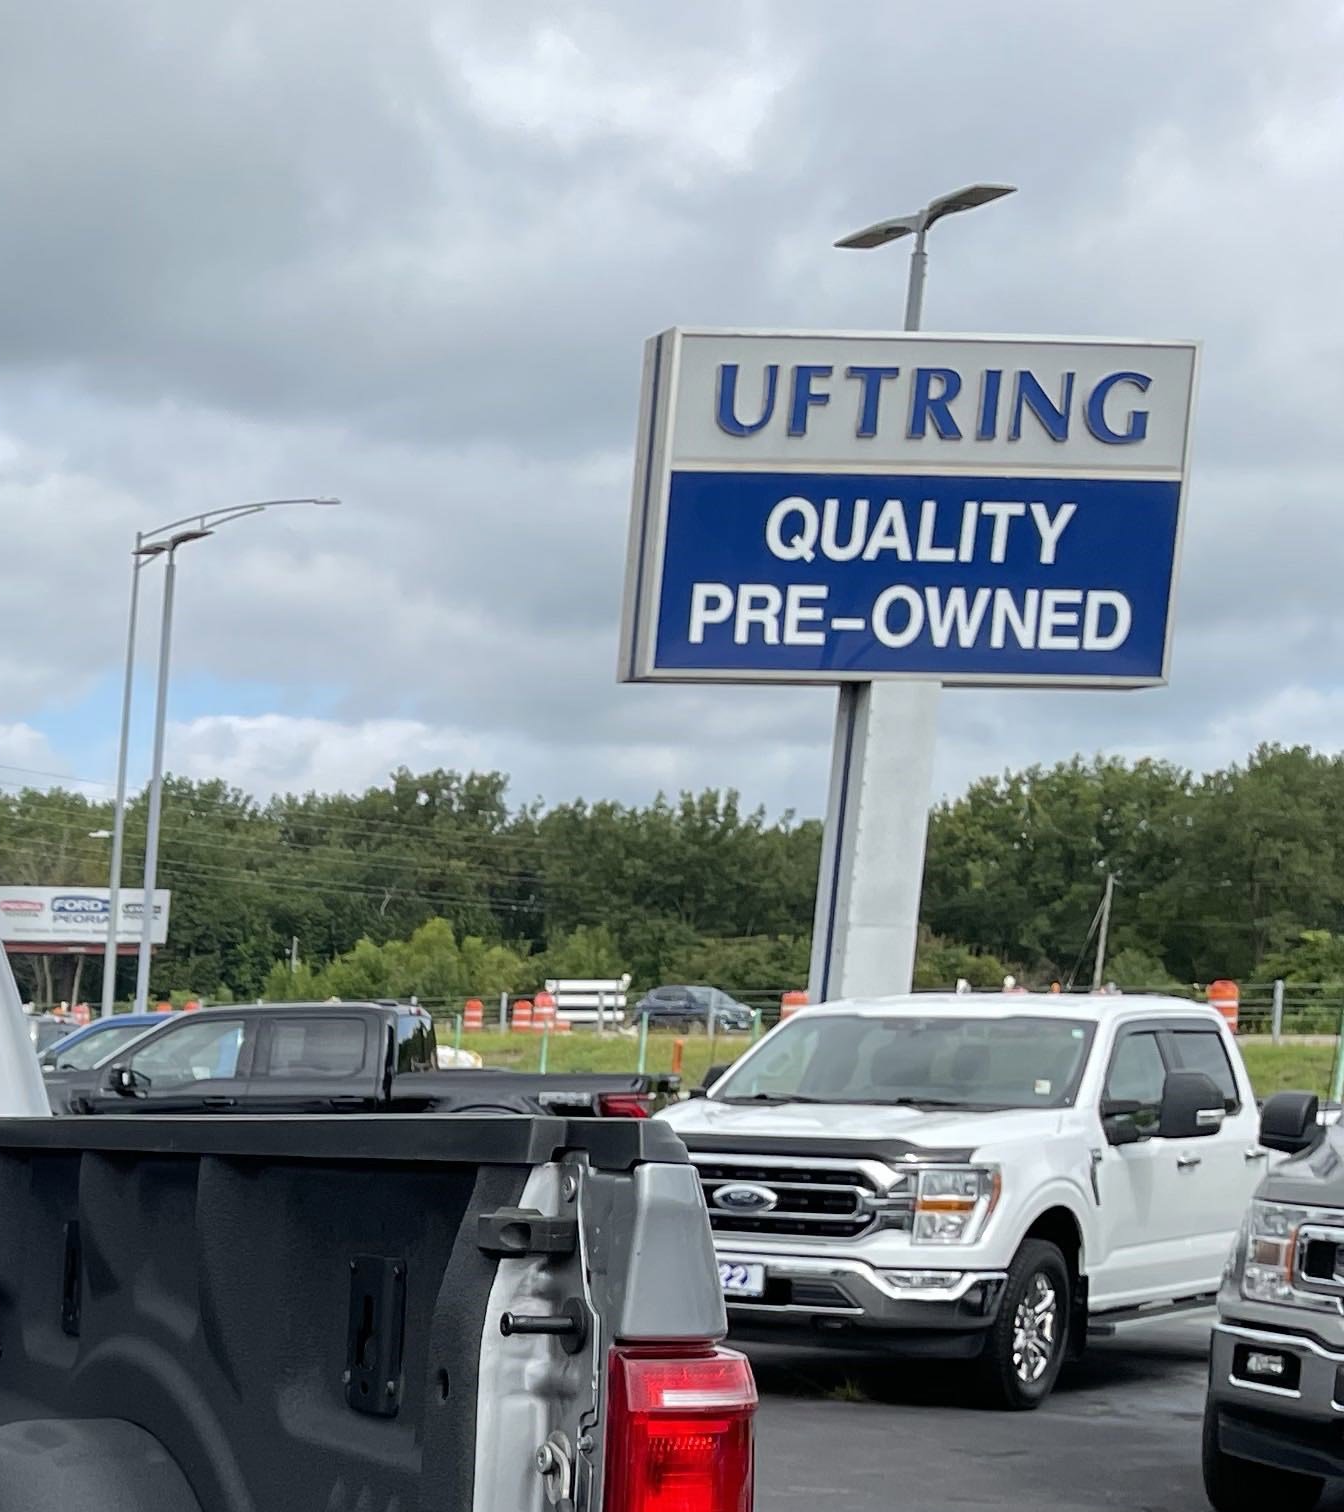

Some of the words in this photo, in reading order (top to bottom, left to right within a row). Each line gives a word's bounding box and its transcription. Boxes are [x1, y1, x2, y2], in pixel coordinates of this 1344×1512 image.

[716, 363, 1154, 445] UFTRING
[765, 496, 1077, 563] QUALITY
[688, 582, 1133, 651] PRE-OWNED
[52, 913, 110, 924] PEORIA
[53, 899, 103, 911] FORD
